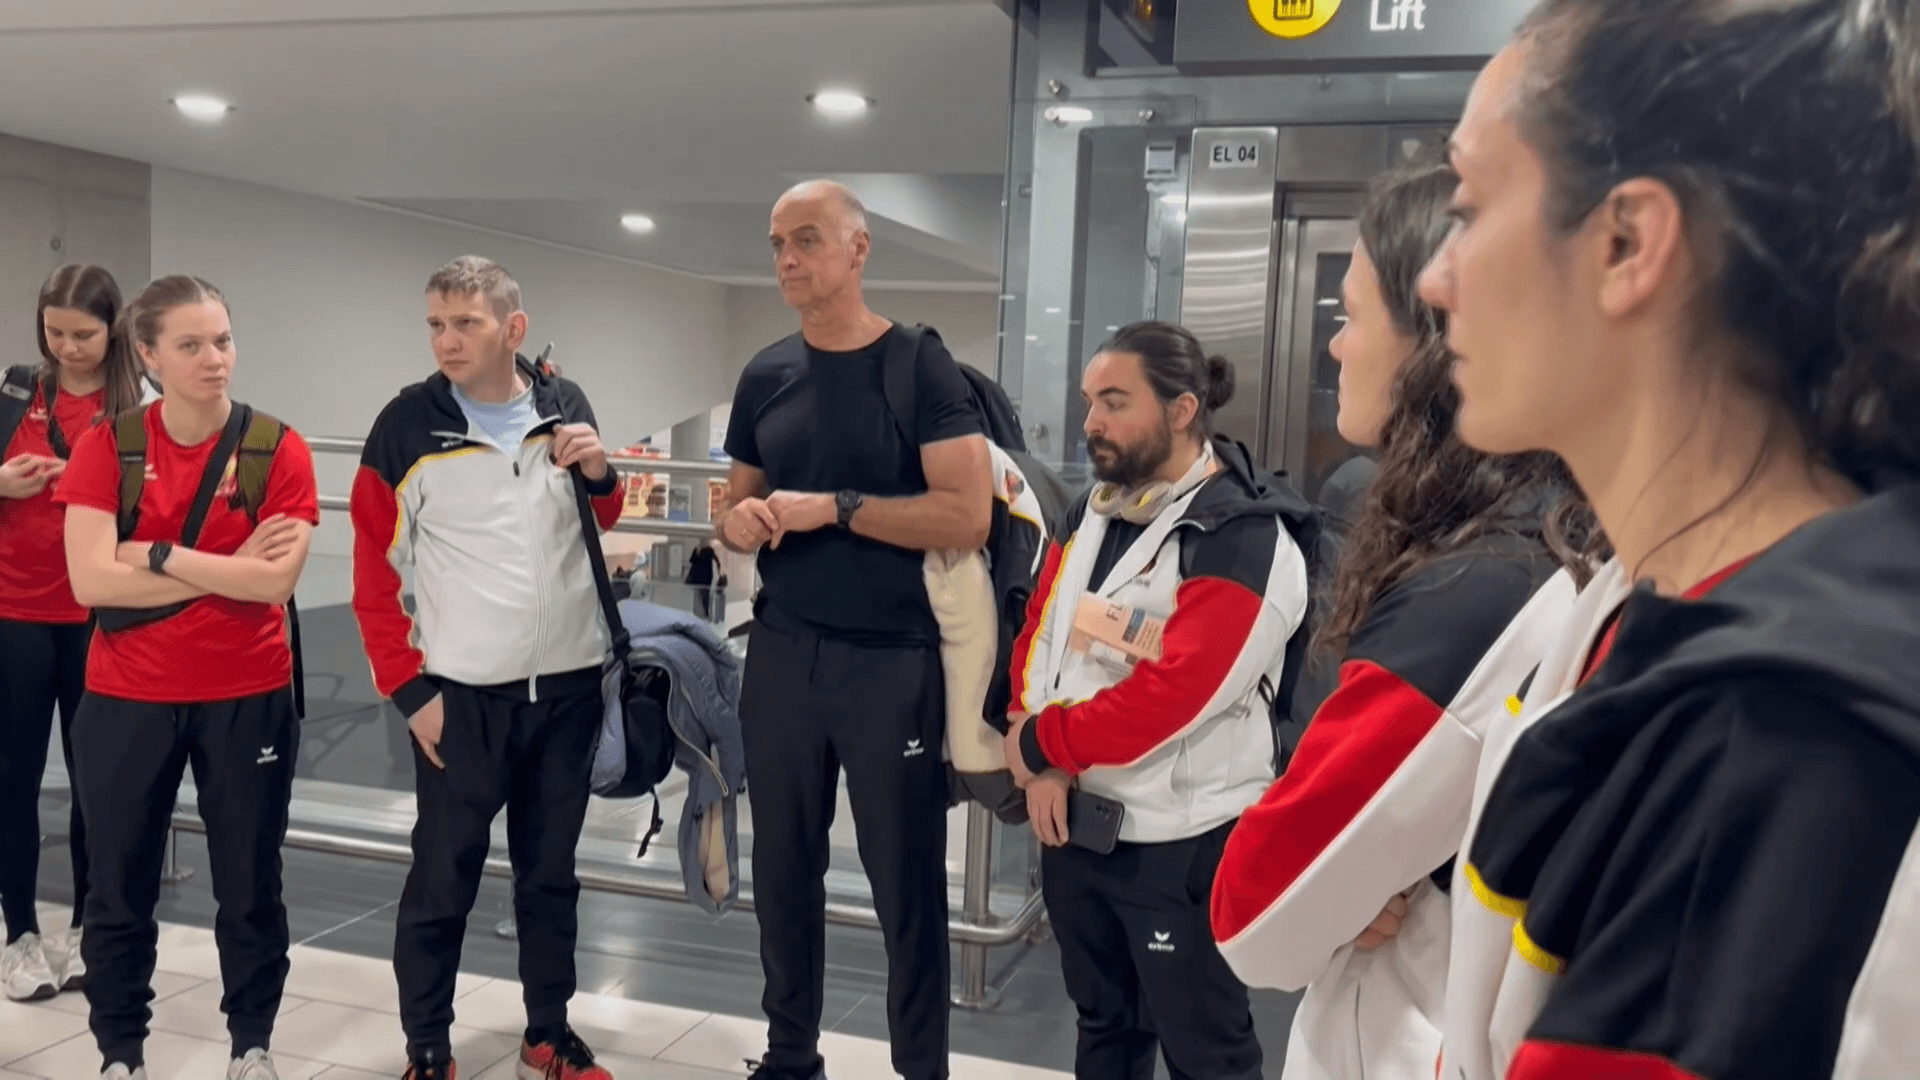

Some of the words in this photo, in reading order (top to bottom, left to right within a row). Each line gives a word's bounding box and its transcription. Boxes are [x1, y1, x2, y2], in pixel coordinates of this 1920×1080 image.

[1370, 0, 1426, 31] Lift
[1213, 145, 1232, 163] EL
[1238, 144, 1256, 162] 04
